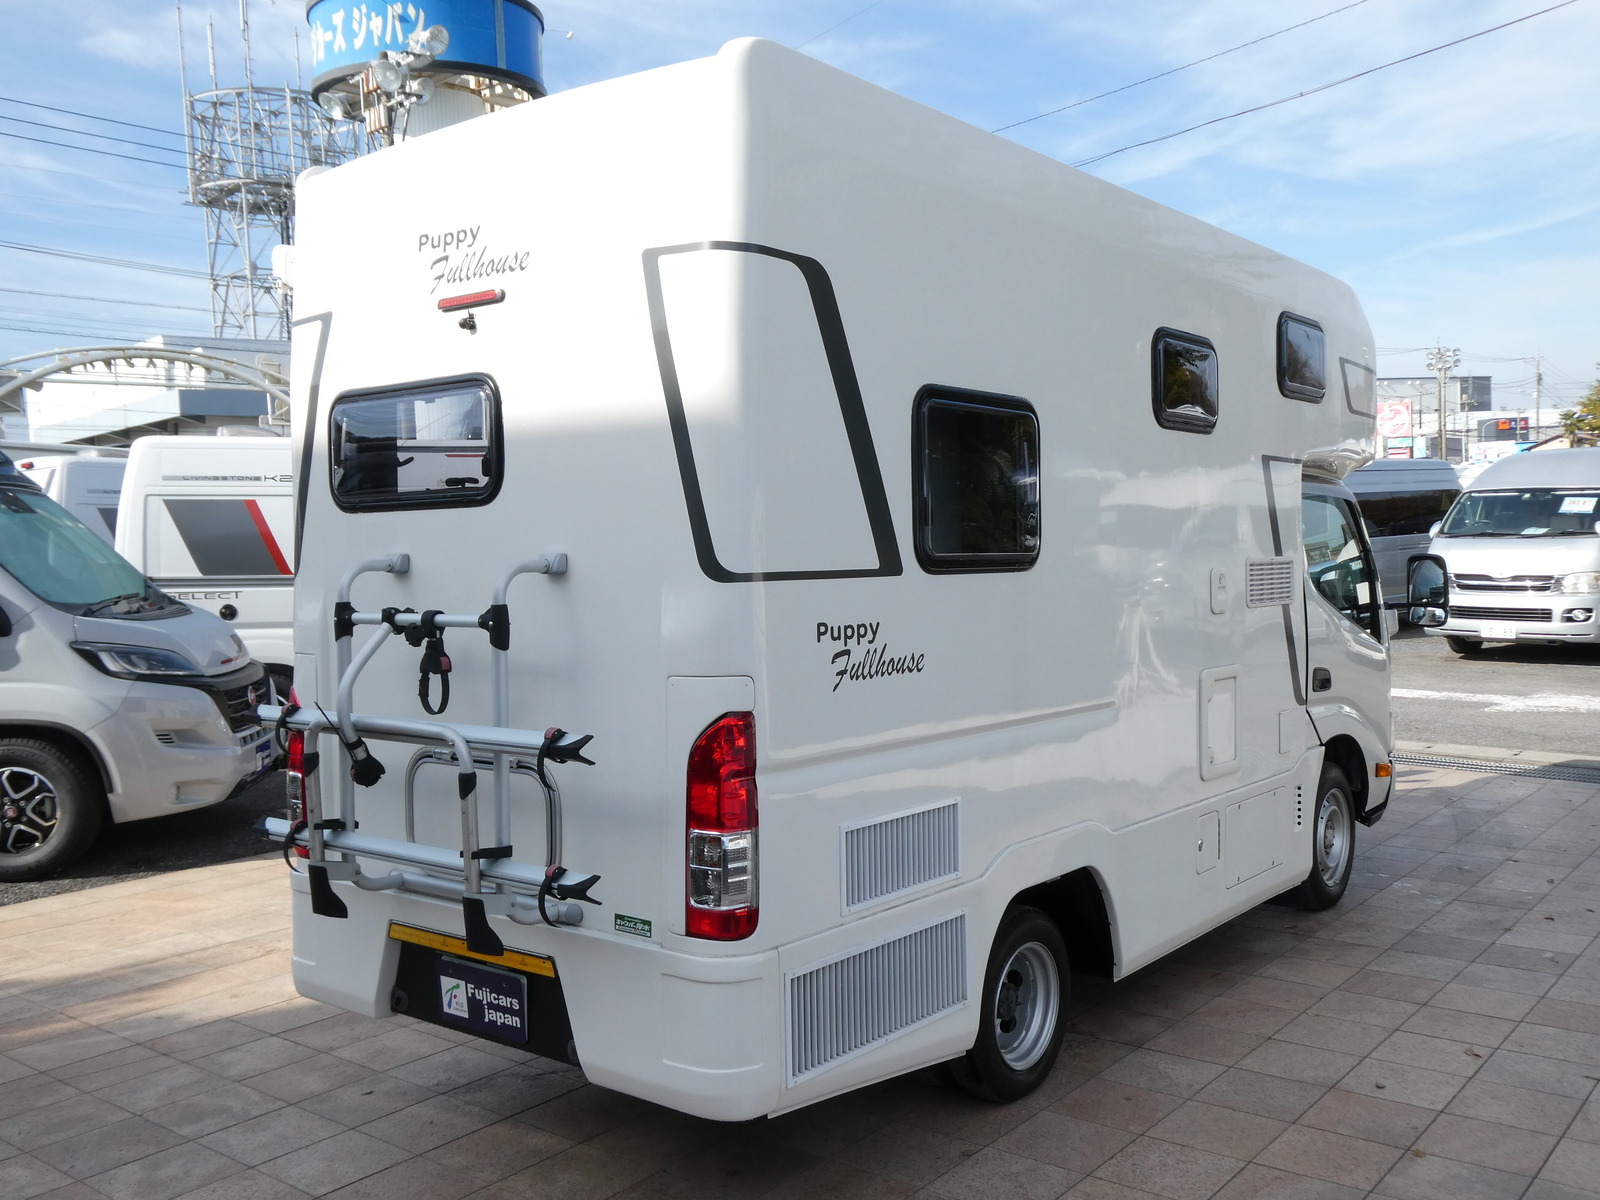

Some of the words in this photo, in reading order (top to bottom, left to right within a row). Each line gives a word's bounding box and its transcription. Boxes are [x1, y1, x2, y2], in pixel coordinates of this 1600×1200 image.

[418, 225, 481, 253] Puppy
[429, 244, 530, 295] Fullhouse
[816, 621, 880, 647] Puppy
[831, 643, 925, 692] Fullhouse
[466, 983, 520, 1010] Fujicars
[484, 1005, 521, 1028] japan
